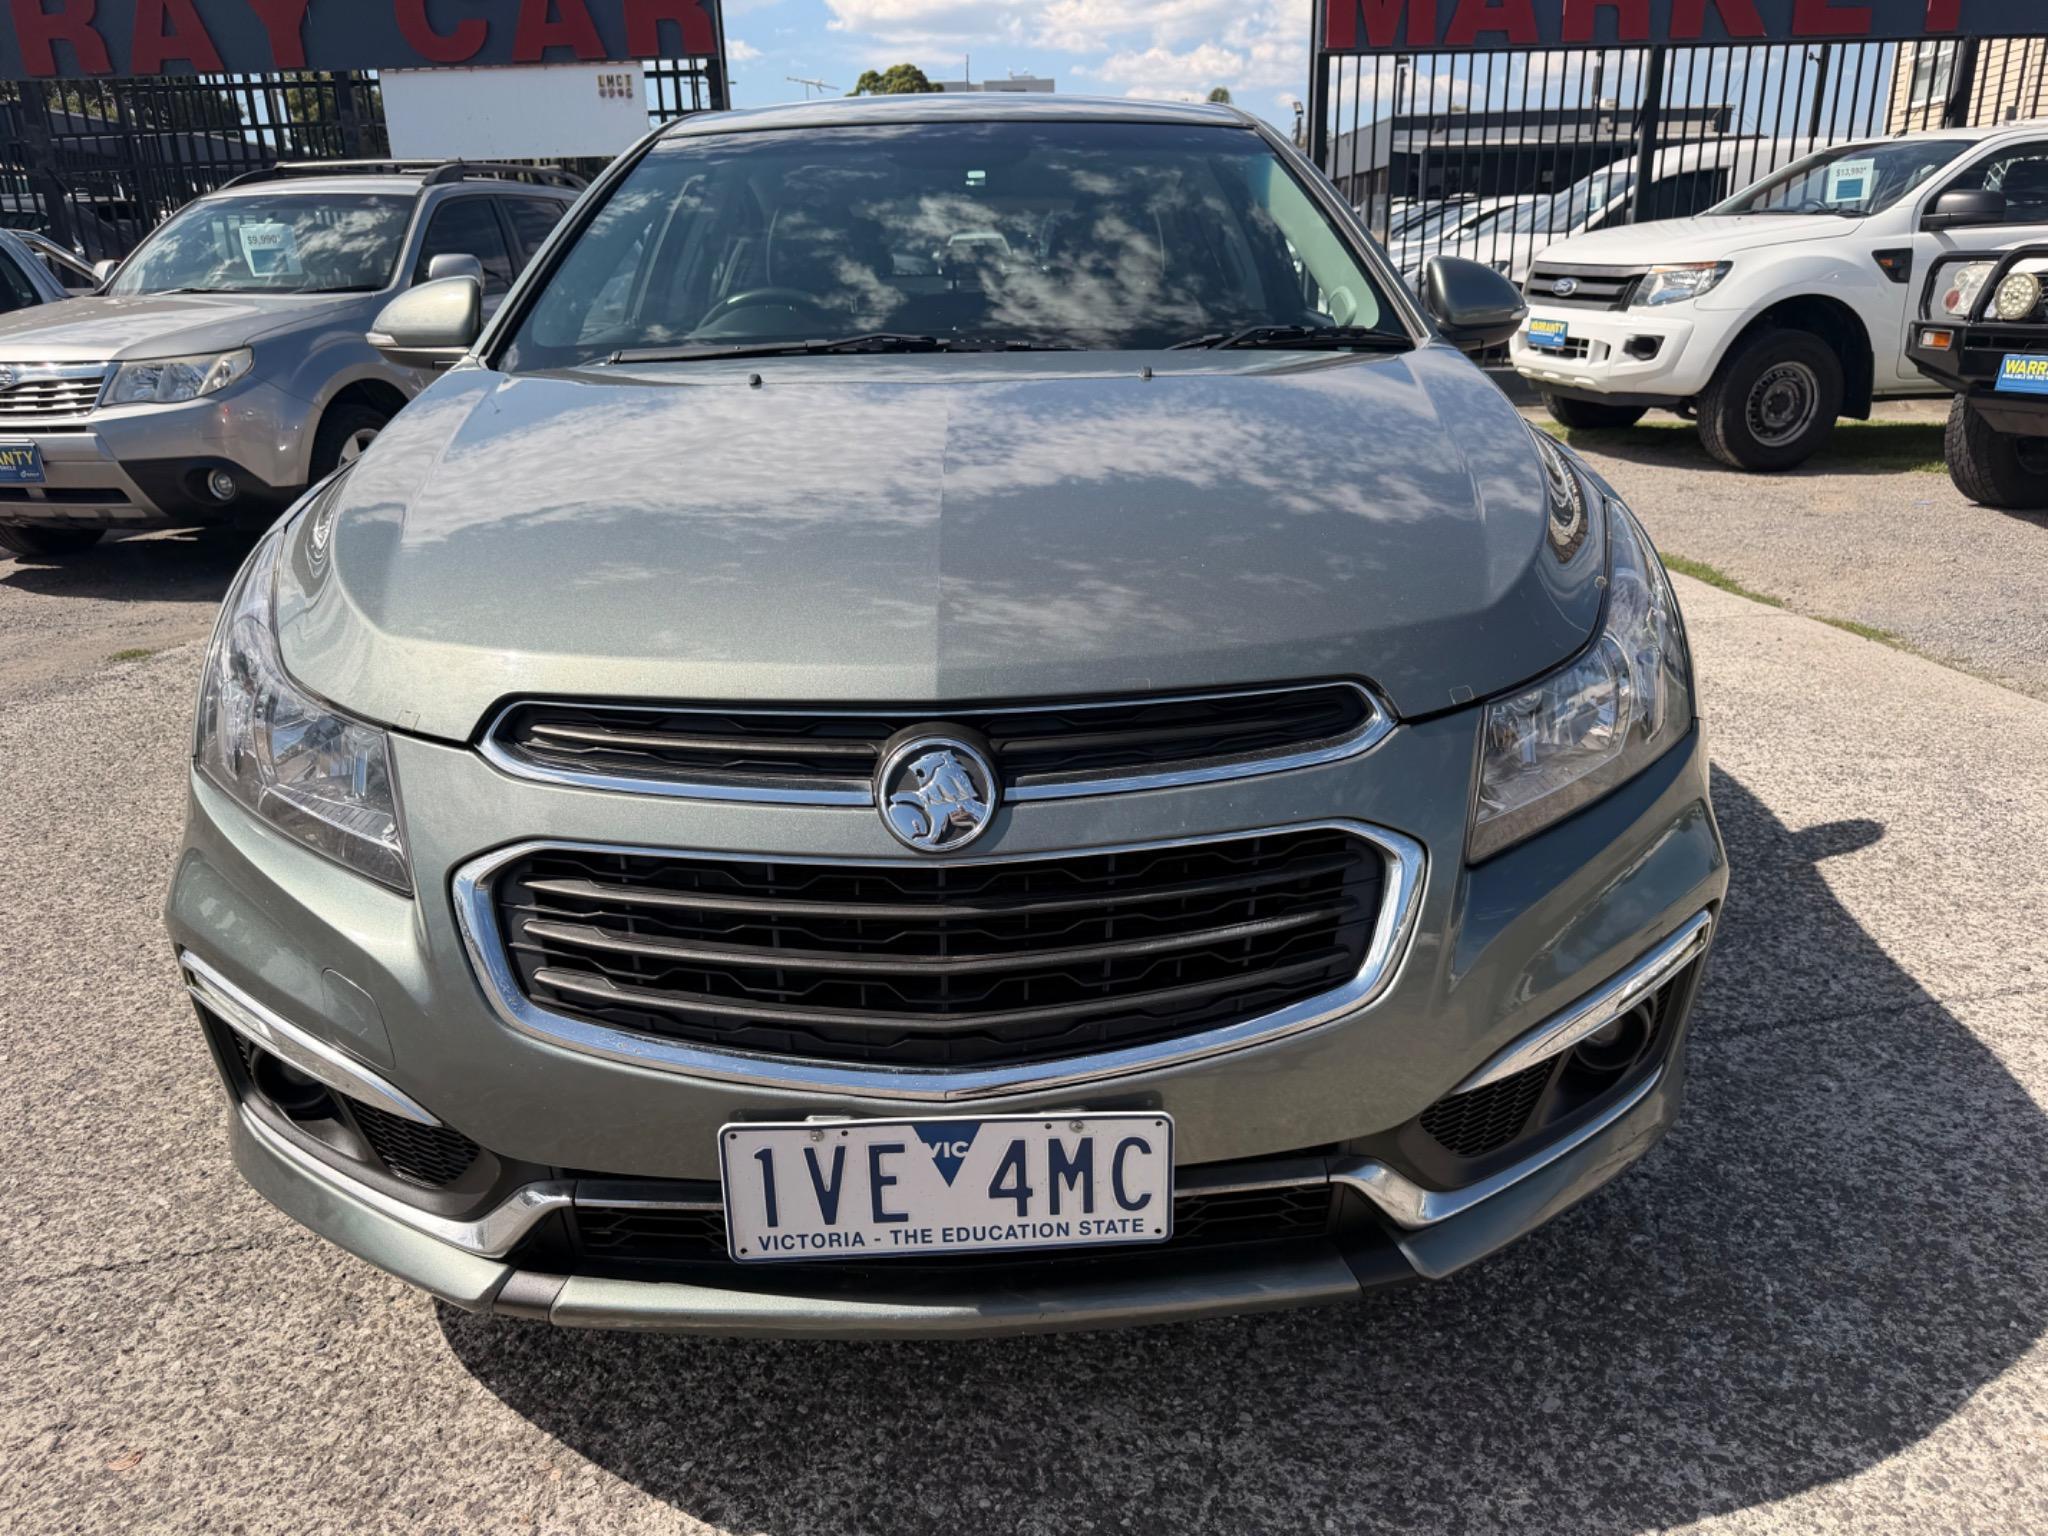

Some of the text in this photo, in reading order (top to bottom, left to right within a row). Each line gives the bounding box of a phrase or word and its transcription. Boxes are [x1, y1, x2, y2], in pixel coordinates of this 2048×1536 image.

[598, 74, 632, 88] LMCT
[2006, 359, 2048, 376] WARR
[928, 1141, 969, 1158] VIC
[754, 1136, 1152, 1228] 1VE 4MC
[758, 1231, 866, 1251] VICTORIA
[889, 1228, 933, 1245] THE
[942, 1221, 1070, 1243] EDUCATION
[1079, 1217, 1144, 1236] STATE
